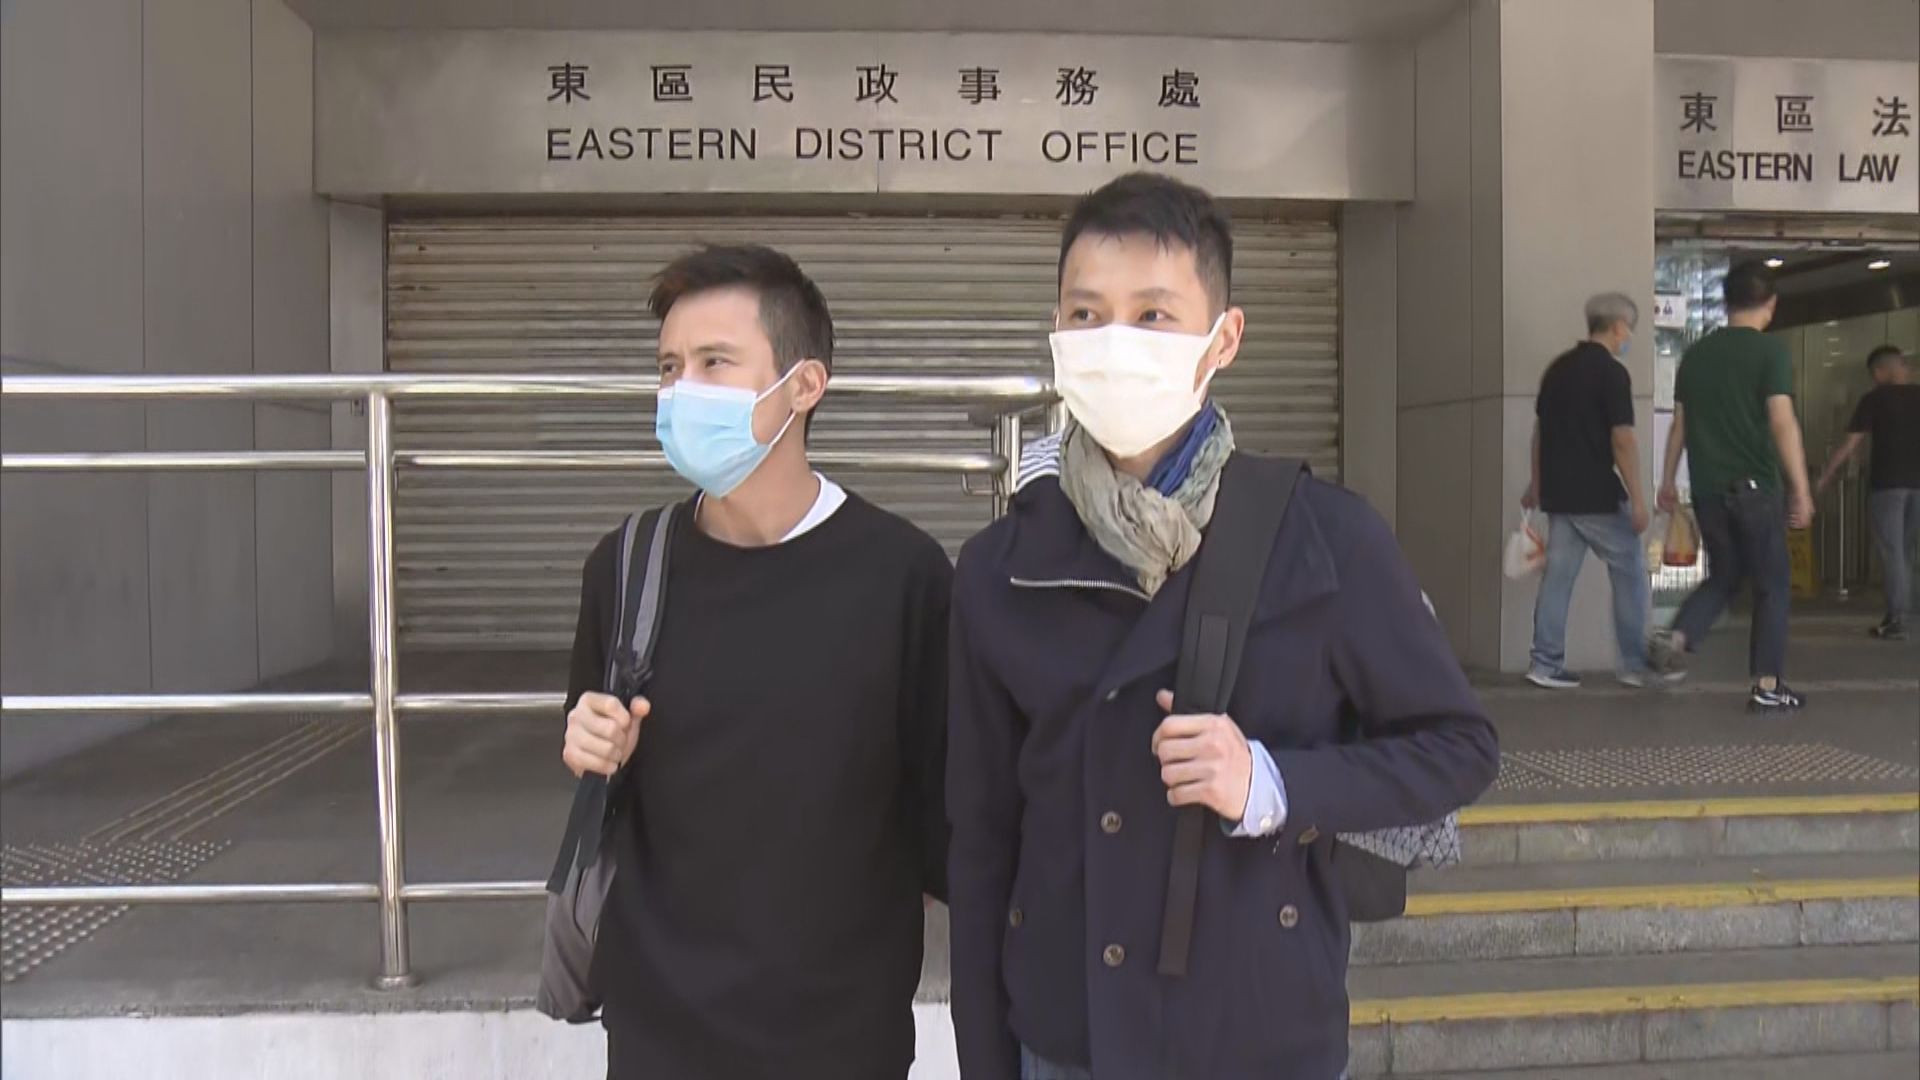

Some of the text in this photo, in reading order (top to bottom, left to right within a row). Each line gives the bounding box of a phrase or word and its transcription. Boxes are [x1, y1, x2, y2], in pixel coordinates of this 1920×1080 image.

[547, 63, 1201, 107] 東區民政事務處
[1679, 91, 1911, 137] 東區法
[547, 127, 1198, 164] EASTERN DISTRICT OFFICE
[1678, 149, 1900, 183] EASTERN LAW
